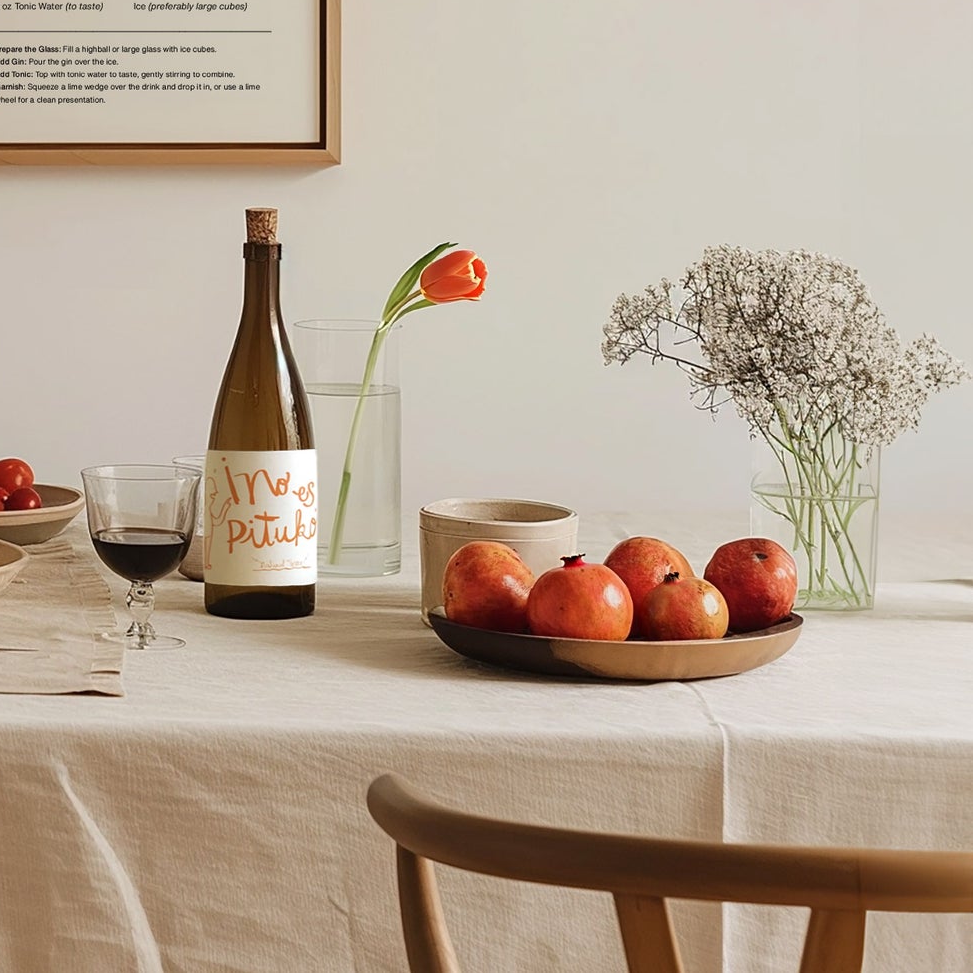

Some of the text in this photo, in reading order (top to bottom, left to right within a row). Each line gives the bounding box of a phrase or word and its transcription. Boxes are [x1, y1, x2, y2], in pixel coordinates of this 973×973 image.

[1, 3, 13, 11] oz
[14, 1, 37, 11] Tonic
[37, 1, 64, 11] Water
[64, 1, 78, 12] (to
[78, 1, 105, 12] taste)
[133, 1, 249, 13] Ice (preferably large cubes)
[23, 45, 38, 54] the
[38, 44, 62, 54] Glass:
[62, 45, 75, 54] Fill
[81, 45, 111, 56] highball
[121, 45, 141, 56] large
[141, 45, 162, 56] glass
[162, 45, 179, 54] with
[179, 45, 192, 54] ice
[192, 45, 218, 54] cubes.
[10, 57, 28, 66] Gin:
[28, 57, 47, 66] Pour
[47, 57, 60, 66] the
[60, 57, 73, 68] gin
[91, 57, 105, 66] the
[105, 57, 120, 66] ice.
[10, 70, 34, 79] Tonic:
[34, 70, 49, 80] Top
[49, 70, 66, 79] with
[66, 70, 86, 79] tonic
[86, 70, 108, 79] water
[108, 70, 118, 79] to
[118, 70, 140, 80] taste,
[140, 70, 165, 81] gently
[165, 70, 191, 81] stirring
[192, 70, 201, 79] to
[201, 70, 236, 79] combine.
[27, 82, 60, 93] Squeeze
[67, 82, 84, 91] lime
[83, 82, 110, 93] wedge
[127, 82, 141, 91] the
[141, 82, 161, 91] drink
[161, 82, 177, 91] and
[177, 82, 196, 93] drop
[196, 82, 203, 91] it
[202, 82, 213, 92] in,
[244, 82, 261, 91] lime
[17, 95, 29, 104] for
[36, 95, 57, 104] clean
[57, 95, 107, 106] presentation.
